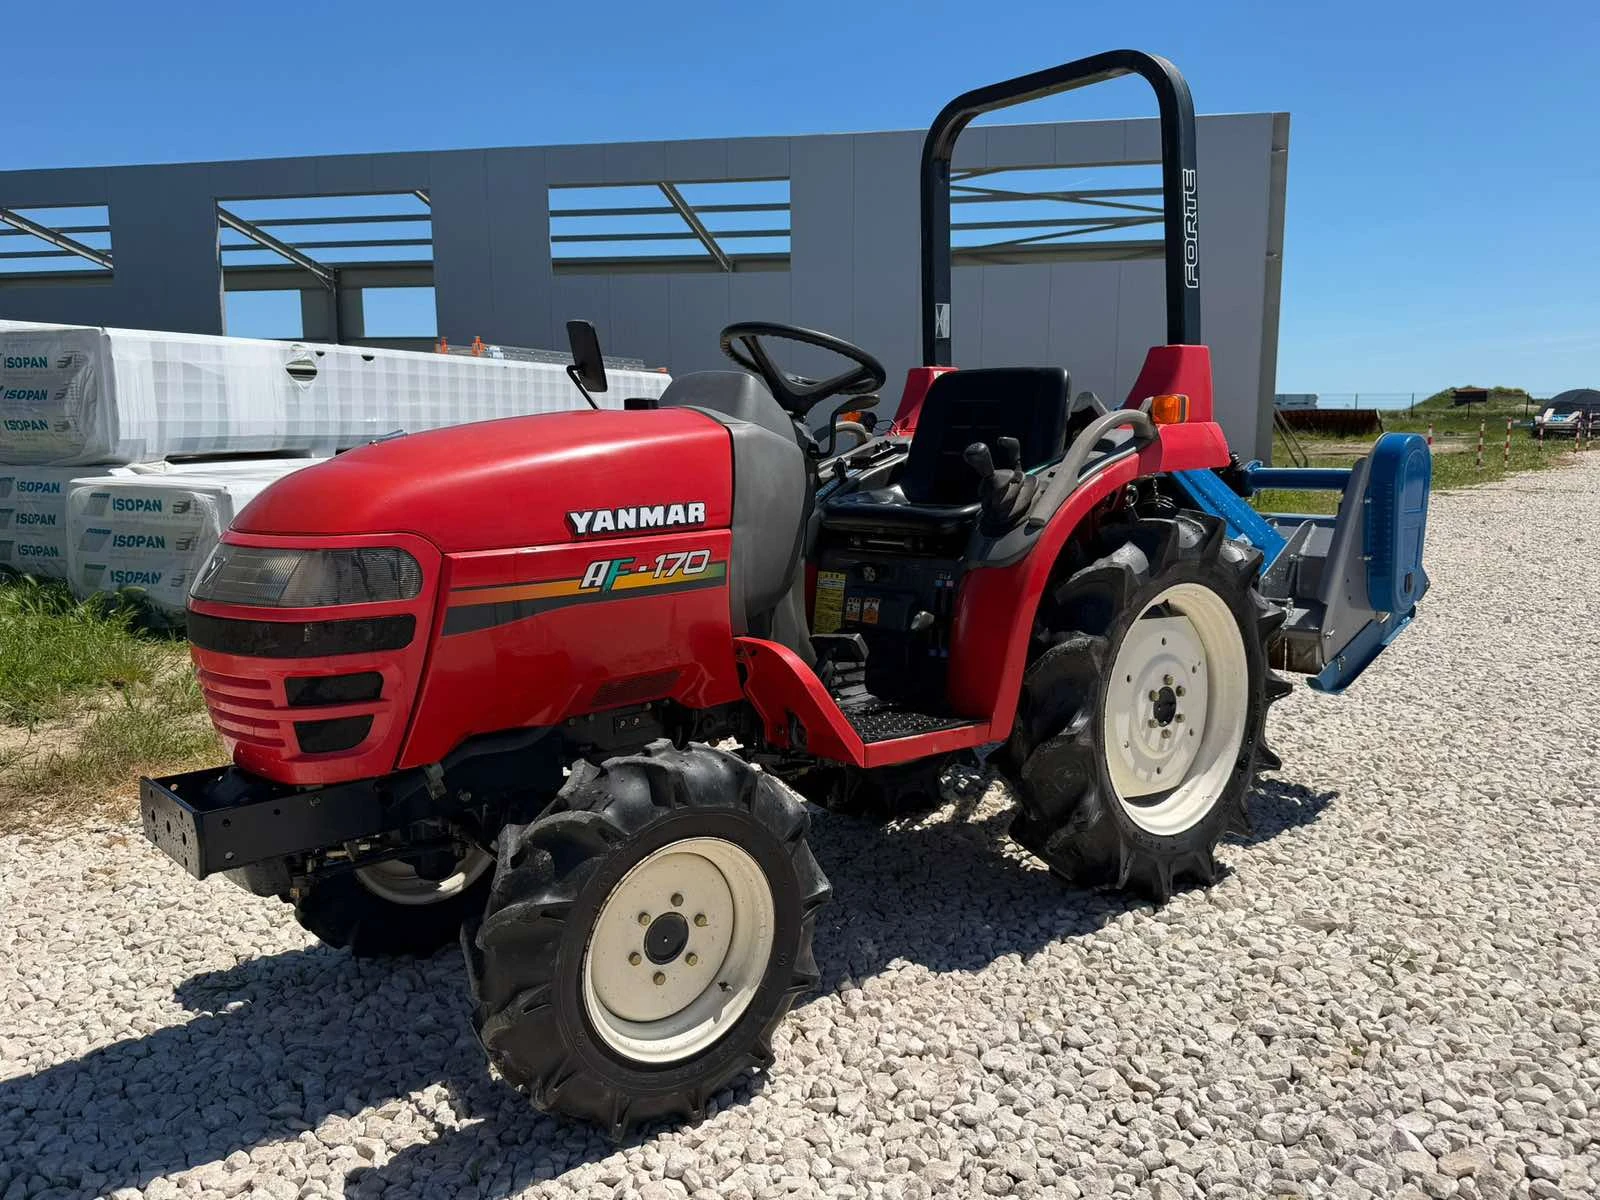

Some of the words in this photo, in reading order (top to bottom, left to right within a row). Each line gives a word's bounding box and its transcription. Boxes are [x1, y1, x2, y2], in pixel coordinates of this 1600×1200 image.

[1182, 168, 1199, 289] FORTE
[4, 356, 48, 369] ISOPAN
[4, 389, 48, 401] ISOPAN
[4, 420, 49, 431] ISOPAN
[16, 481, 60, 493] ISOPAN
[112, 498, 162, 512] ISOPAN
[16, 513, 56, 525] ISOPAN
[569, 502, 706, 535] YANMAR
[112, 535, 166, 548] ISOPAN
[18, 544, 59, 557] ISOPAN
[110, 570, 161, 584] ISOPAN
[579, 550, 711, 591] AF-170
